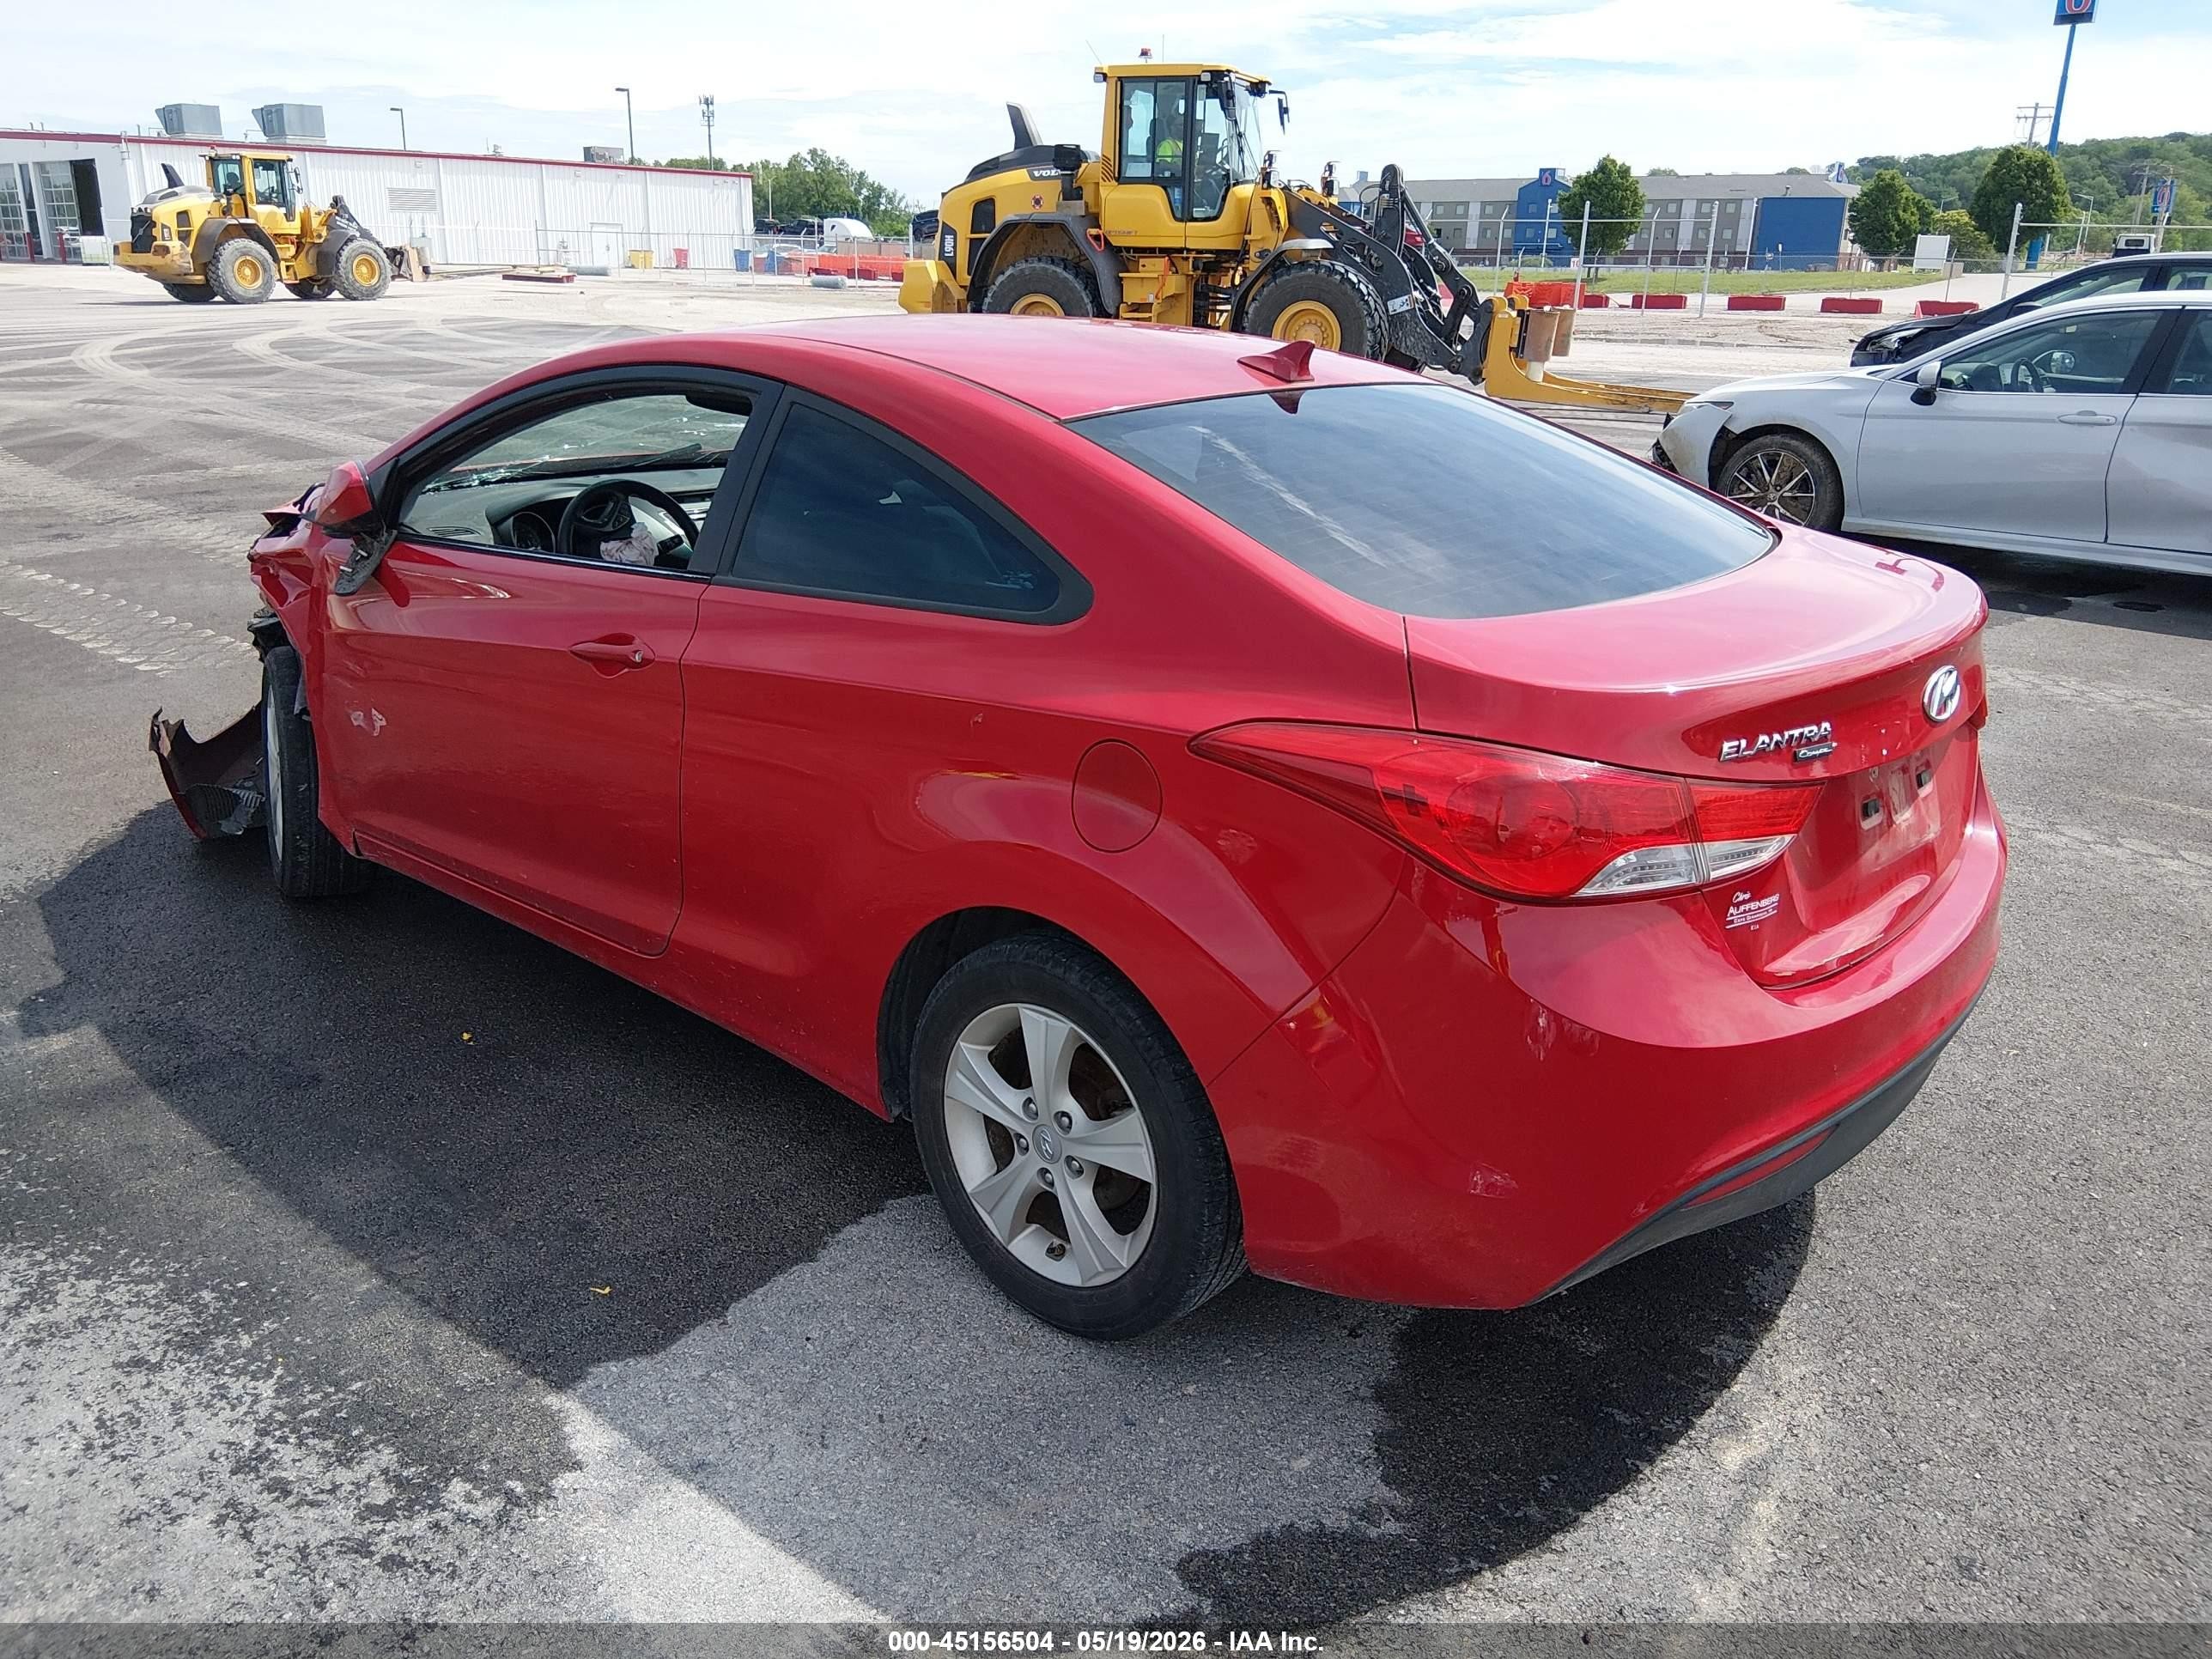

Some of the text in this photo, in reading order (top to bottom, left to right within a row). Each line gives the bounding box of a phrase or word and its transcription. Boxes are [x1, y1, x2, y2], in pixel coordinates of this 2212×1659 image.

[1033, 169, 1061, 178] VOL
[944, 234, 955, 257] L90H
[1719, 721, 1832, 762] ELANTRA
[1727, 893, 1780, 917] AUFFENBERG
